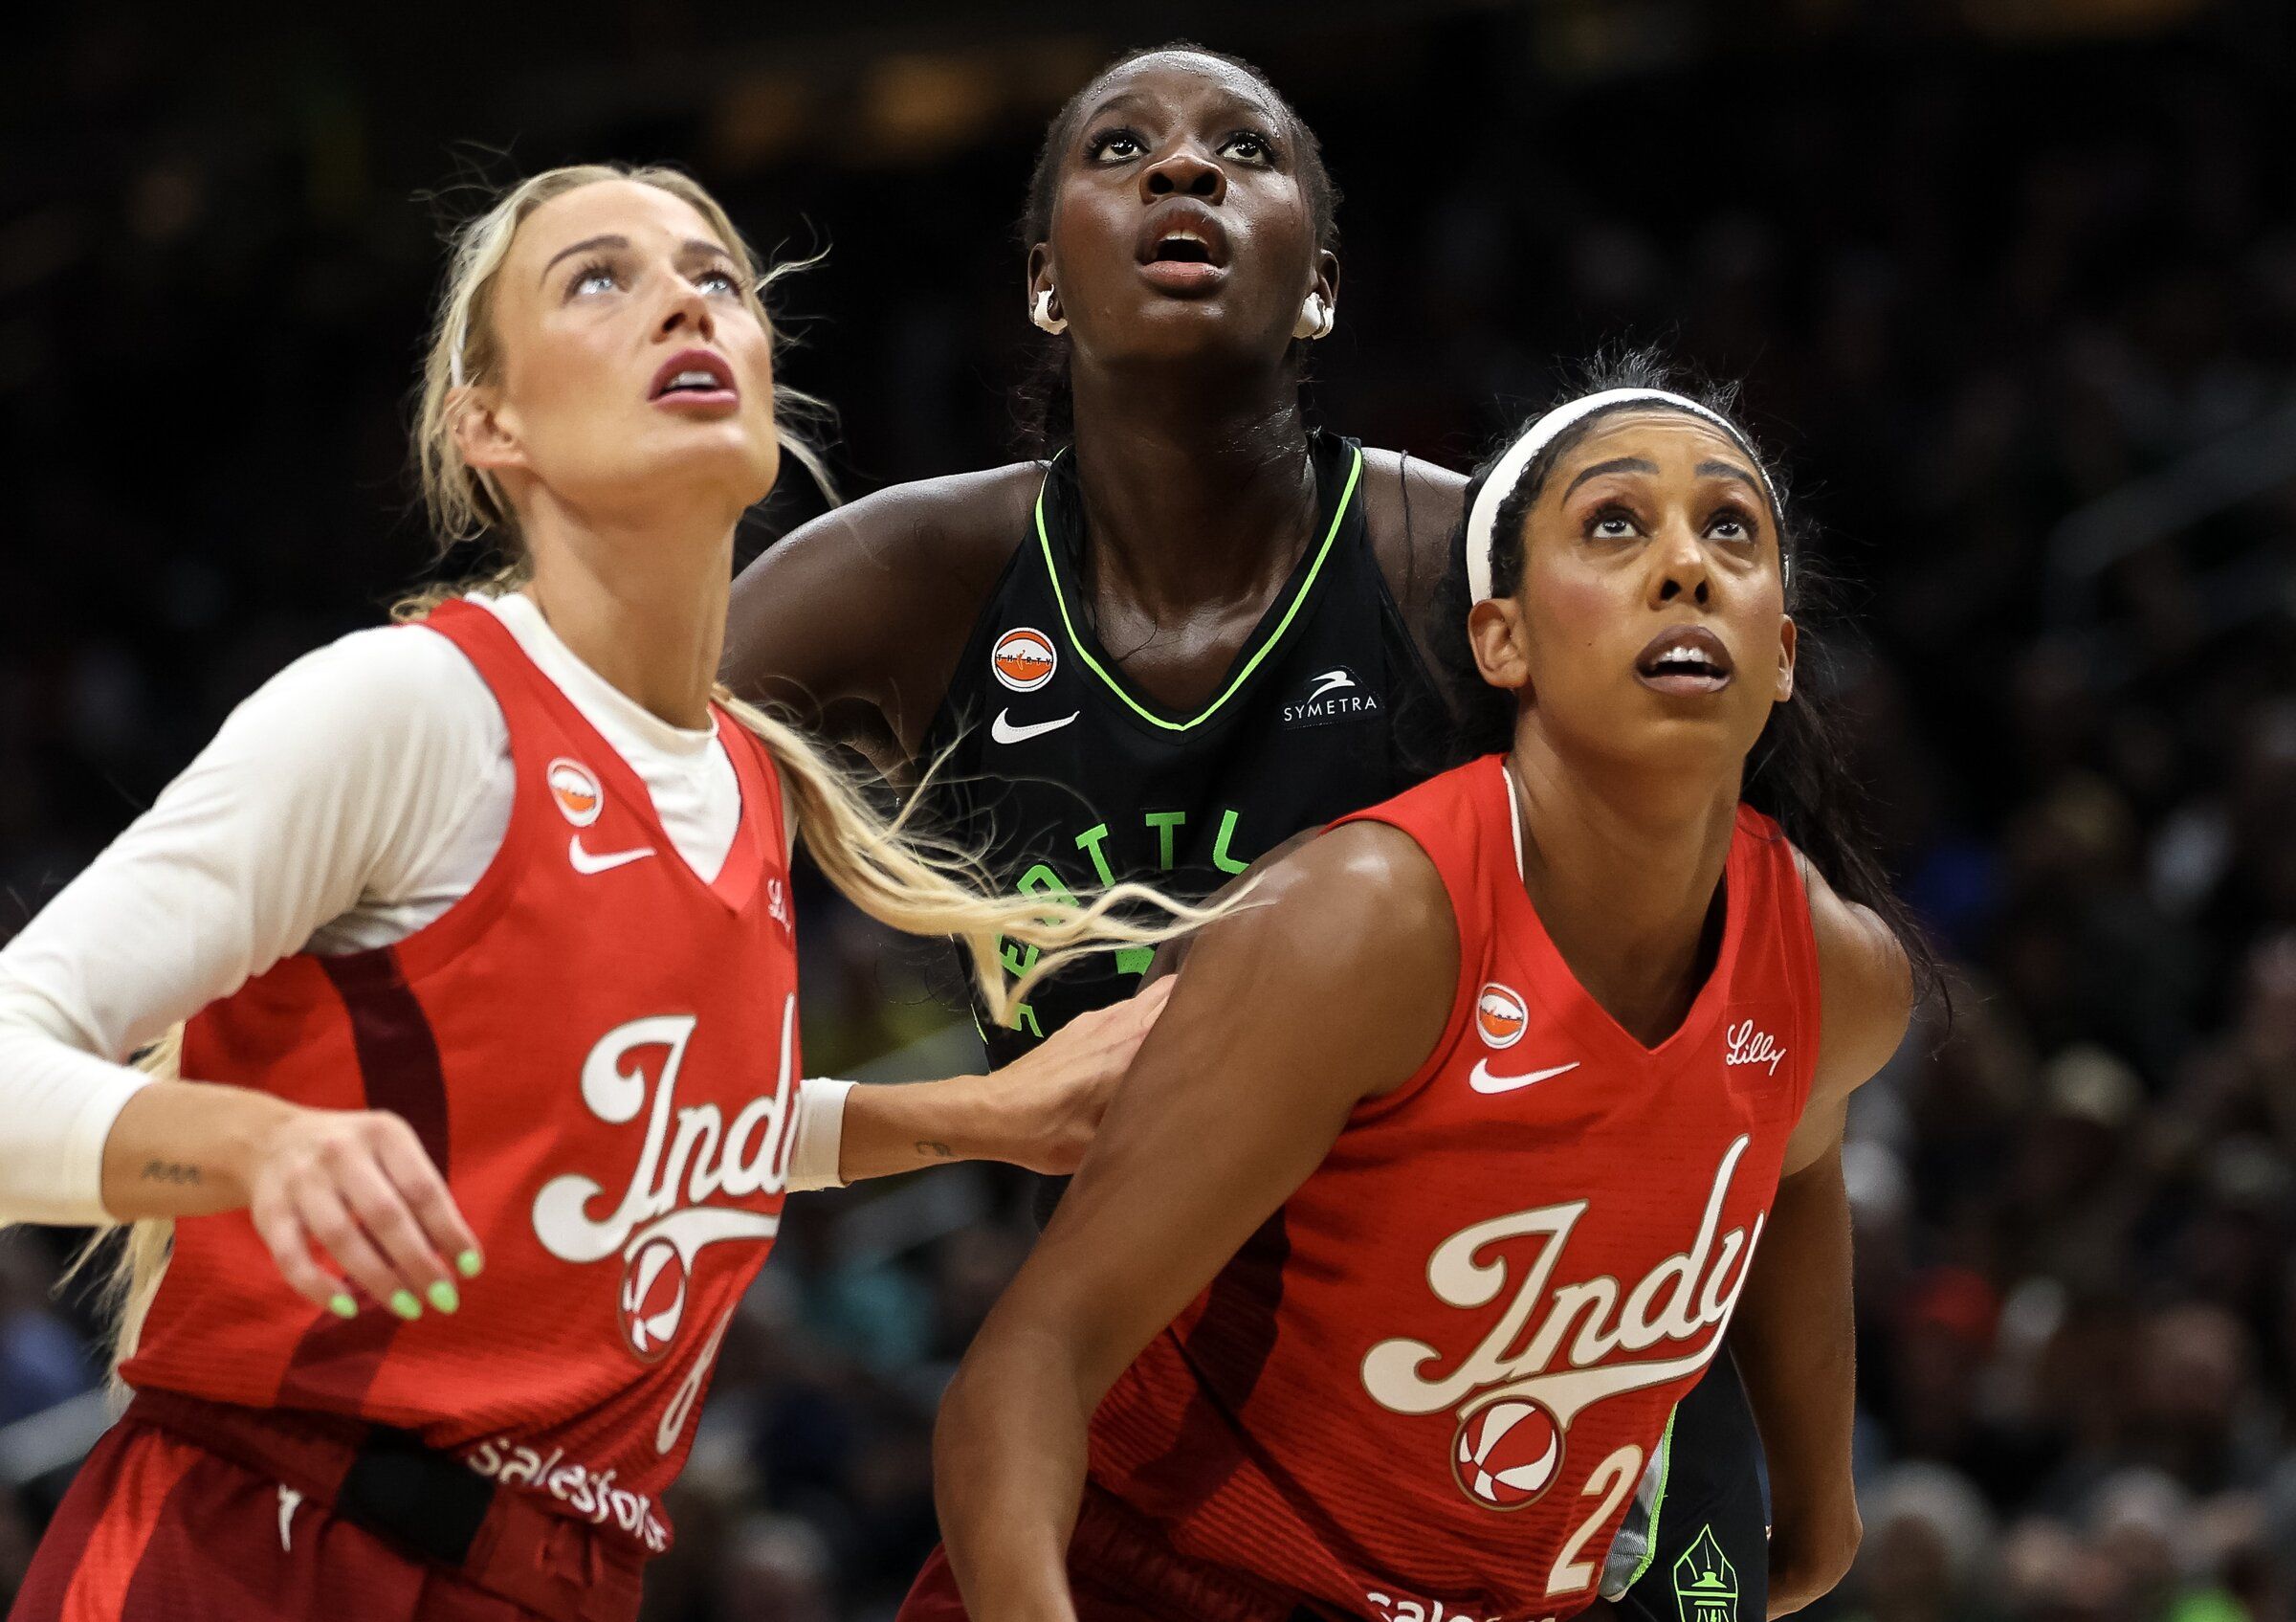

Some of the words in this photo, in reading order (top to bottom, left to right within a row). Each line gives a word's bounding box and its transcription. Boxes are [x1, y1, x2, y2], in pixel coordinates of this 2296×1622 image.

[1283, 695, 1379, 722] SYMETRA
[1725, 1018, 1788, 1077] Lilly
[1359, 1132, 1765, 1432] Indy
[1544, 1444, 1645, 1598] 2
